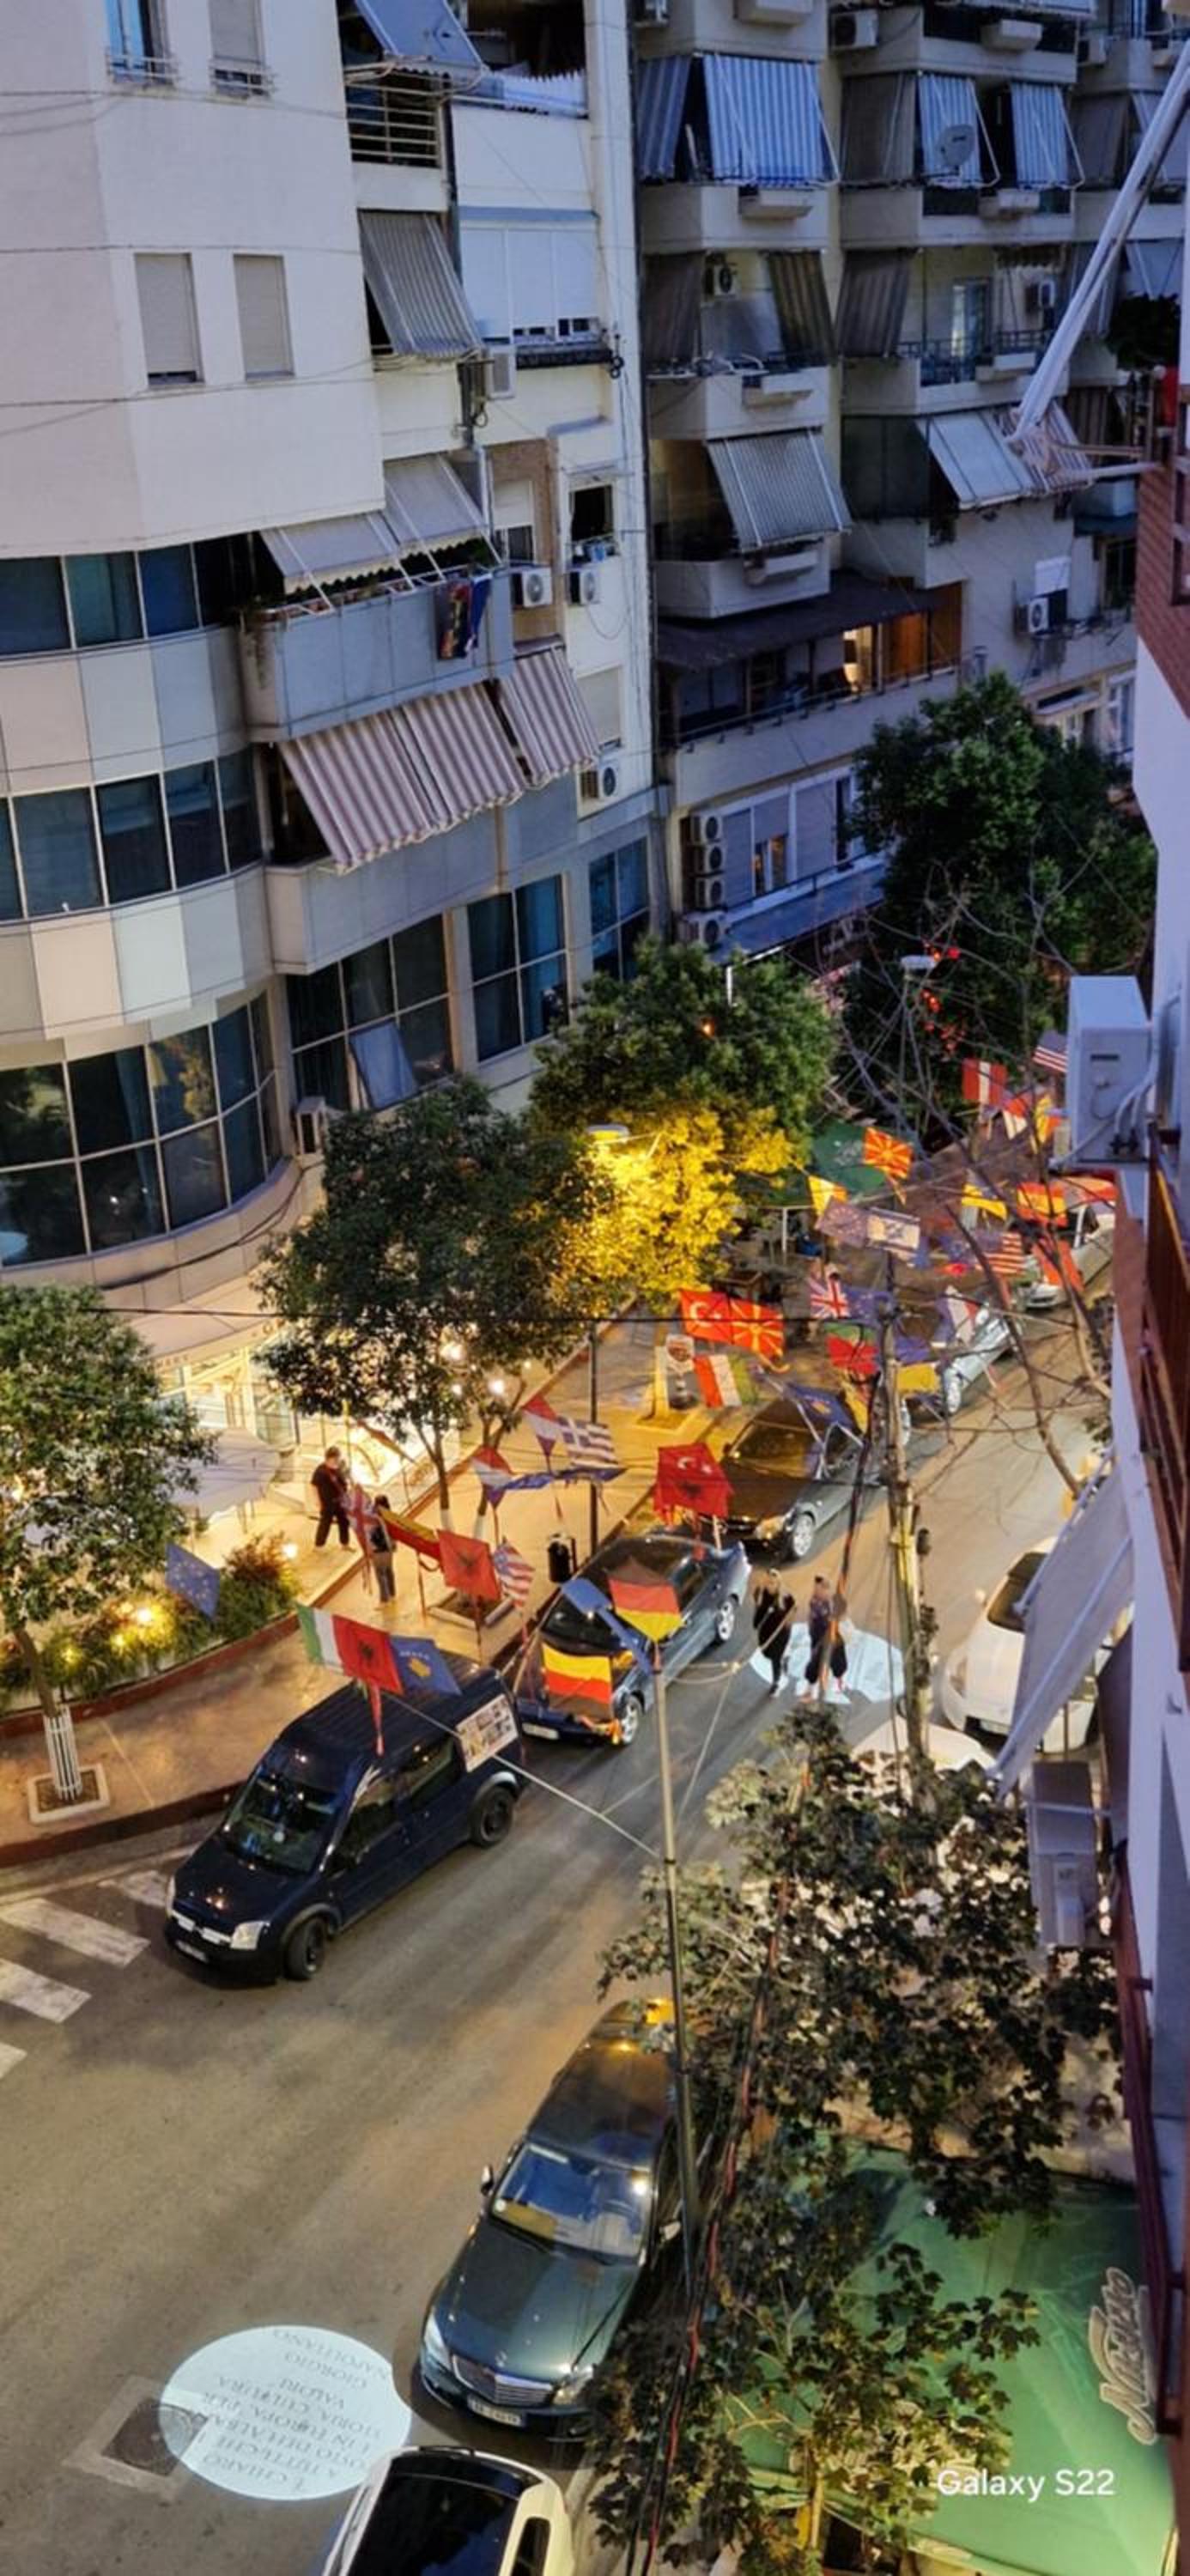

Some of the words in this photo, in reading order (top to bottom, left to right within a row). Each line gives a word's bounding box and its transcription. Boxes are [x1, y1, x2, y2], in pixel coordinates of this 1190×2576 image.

[274, 2330, 385, 2381] NAPOLITANO
[283, 2352, 367, 2390] GIORGIO
[203, 2391, 240, 2414] PER
[213, 2435, 258, 2454] CHE
[331, 2433, 355, 2448] IN
[203, 2454, 288, 2483] CHIARO
